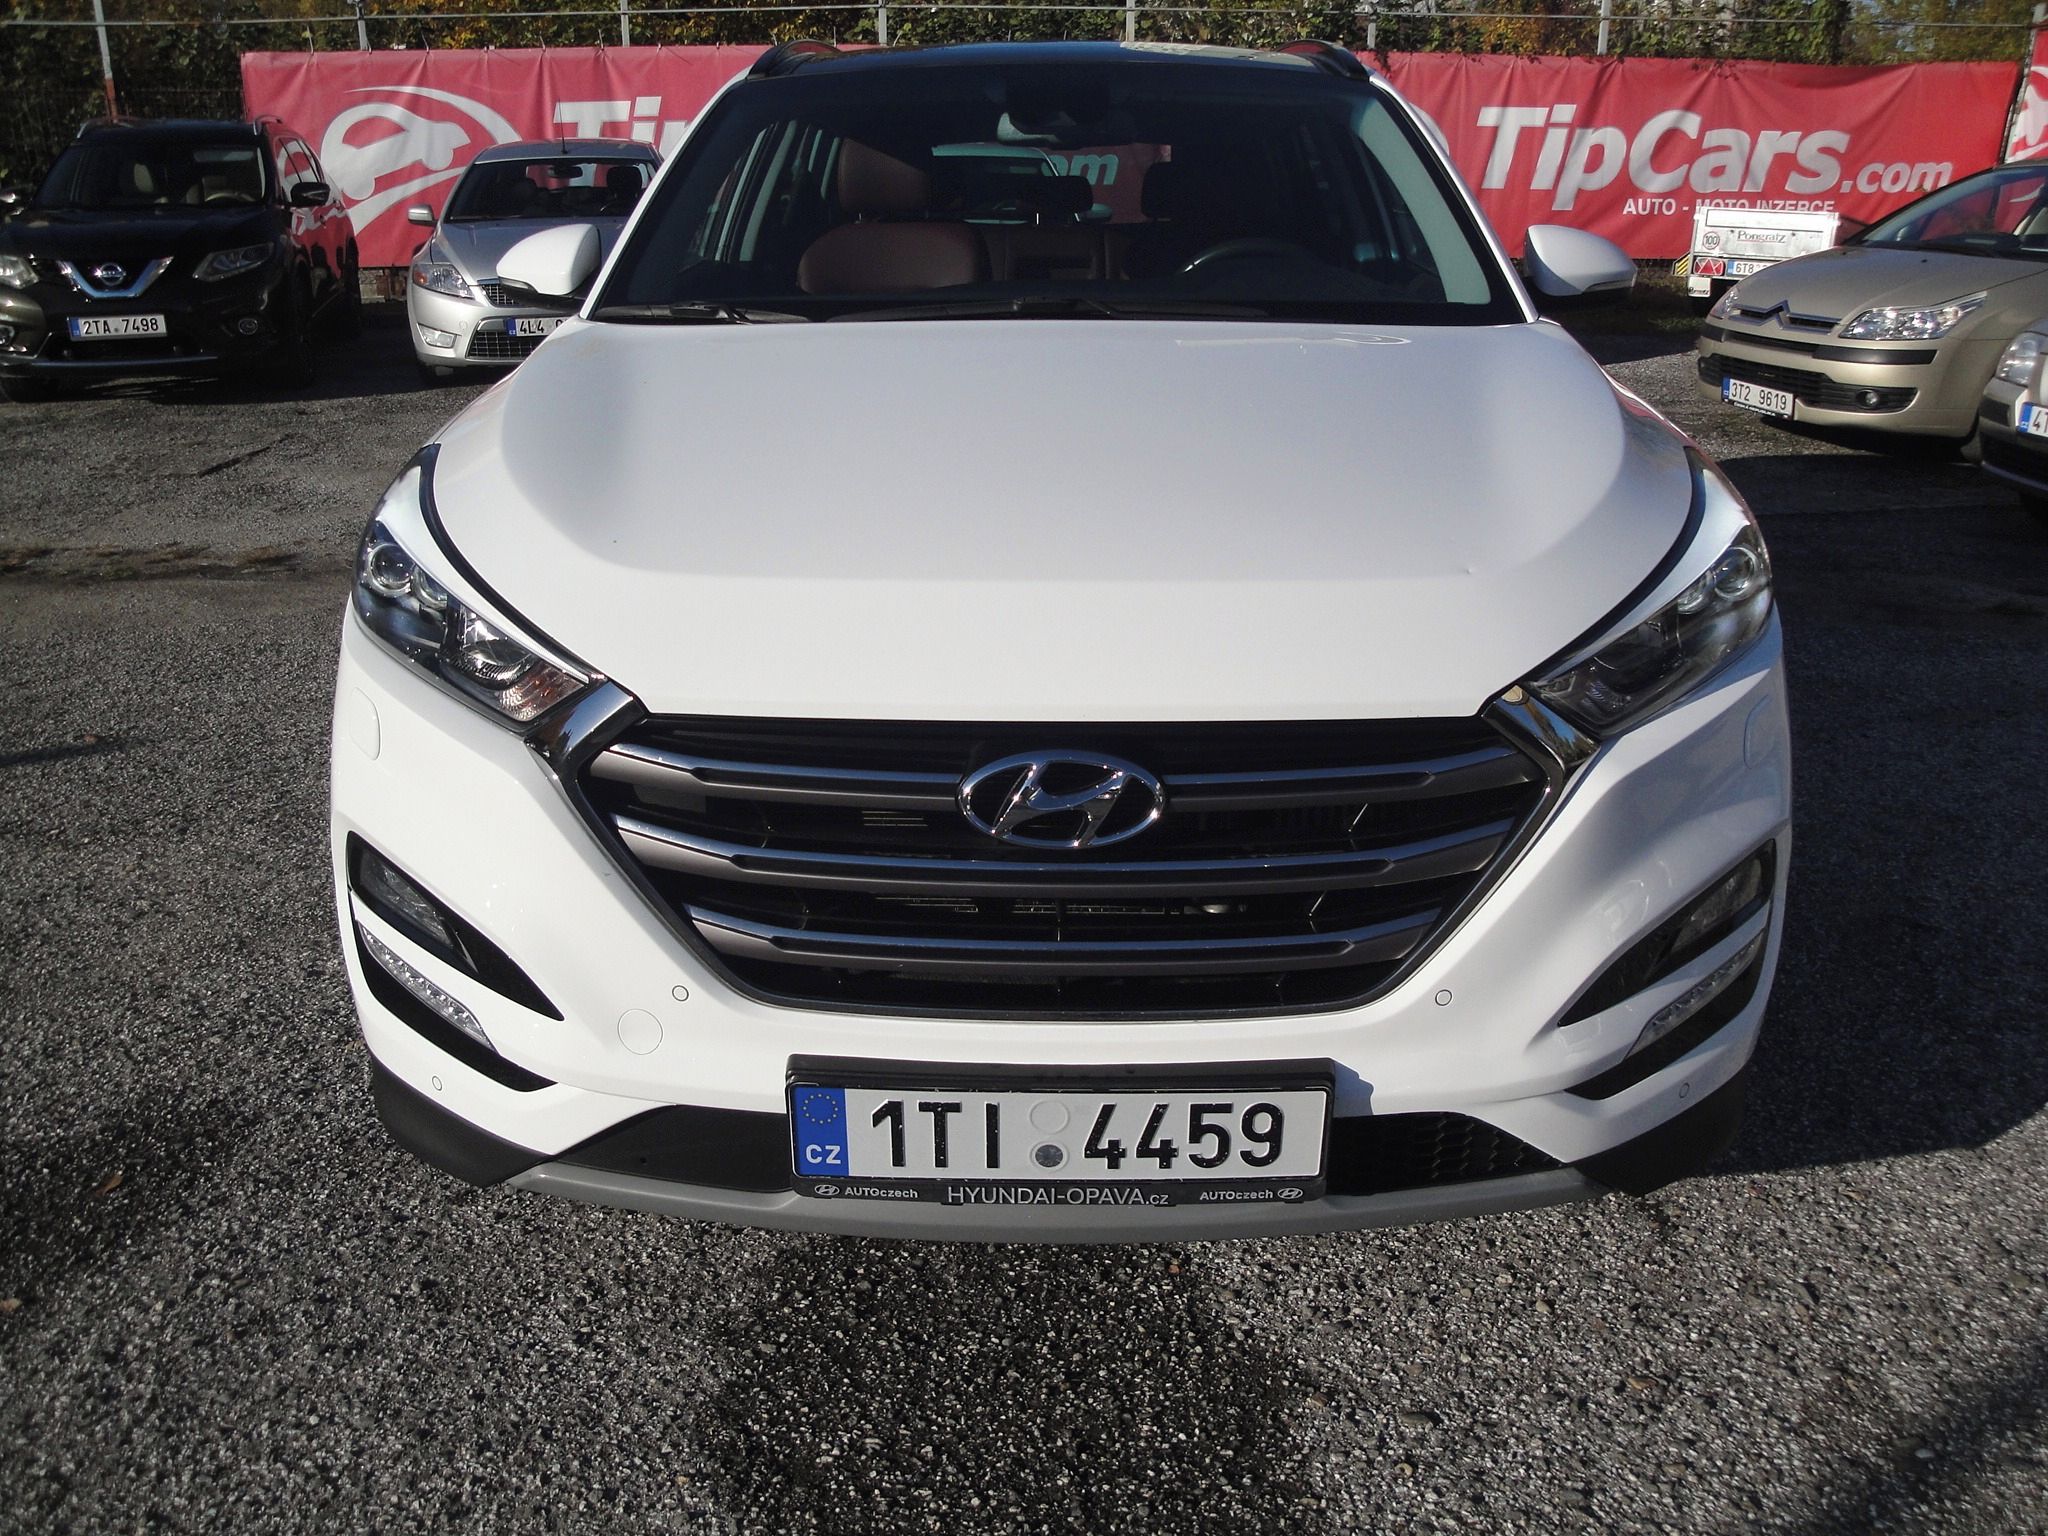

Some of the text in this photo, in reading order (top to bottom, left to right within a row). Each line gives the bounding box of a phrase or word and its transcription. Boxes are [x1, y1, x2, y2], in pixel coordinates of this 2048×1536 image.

[553, 96, 693, 160] Ti
[1476, 103, 1953, 211] TipCars.com
[1623, 199, 1676, 215] AUTO
[1705, 235, 1718, 245] 100
[1737, 230, 1787, 243] Pongratz
[1736, 262, 1754, 273] 6T8
[83, 317, 159, 335] 2TA 7498
[520, 320, 545, 334] 4L4
[1731, 382, 1751, 401] 3T2
[1759, 389, 1787, 410] 9619
[870, 1099, 1285, 1169] 1TI 4459
[806, 1145, 841, 1165] CZ
[844, 1186, 918, 1199] AUTOczech
[948, 1186, 1169, 1205] HYUNDAI-OPAVA.cz
[1200, 1189, 1273, 1201] AUTOczech
